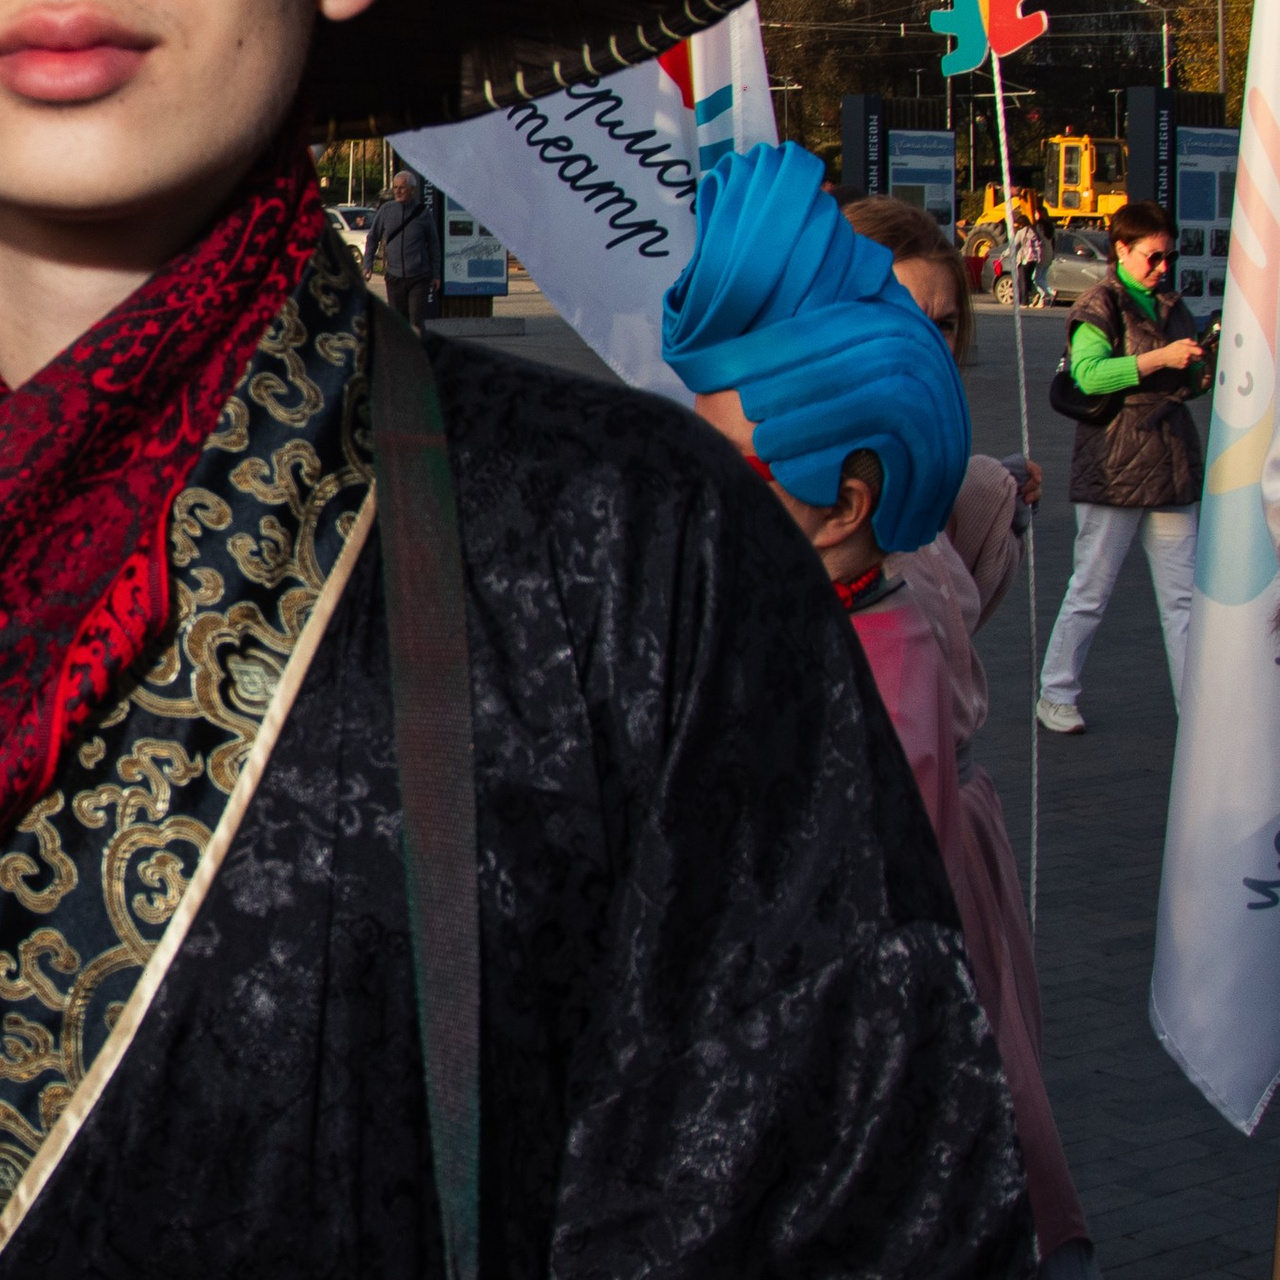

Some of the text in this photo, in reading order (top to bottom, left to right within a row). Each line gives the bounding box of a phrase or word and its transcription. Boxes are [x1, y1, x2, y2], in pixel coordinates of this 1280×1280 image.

[868, 115, 878, 161] НЕБОМ
[1158, 110, 1169, 160] НЕБОМ
[507, 103, 669, 257] театр
